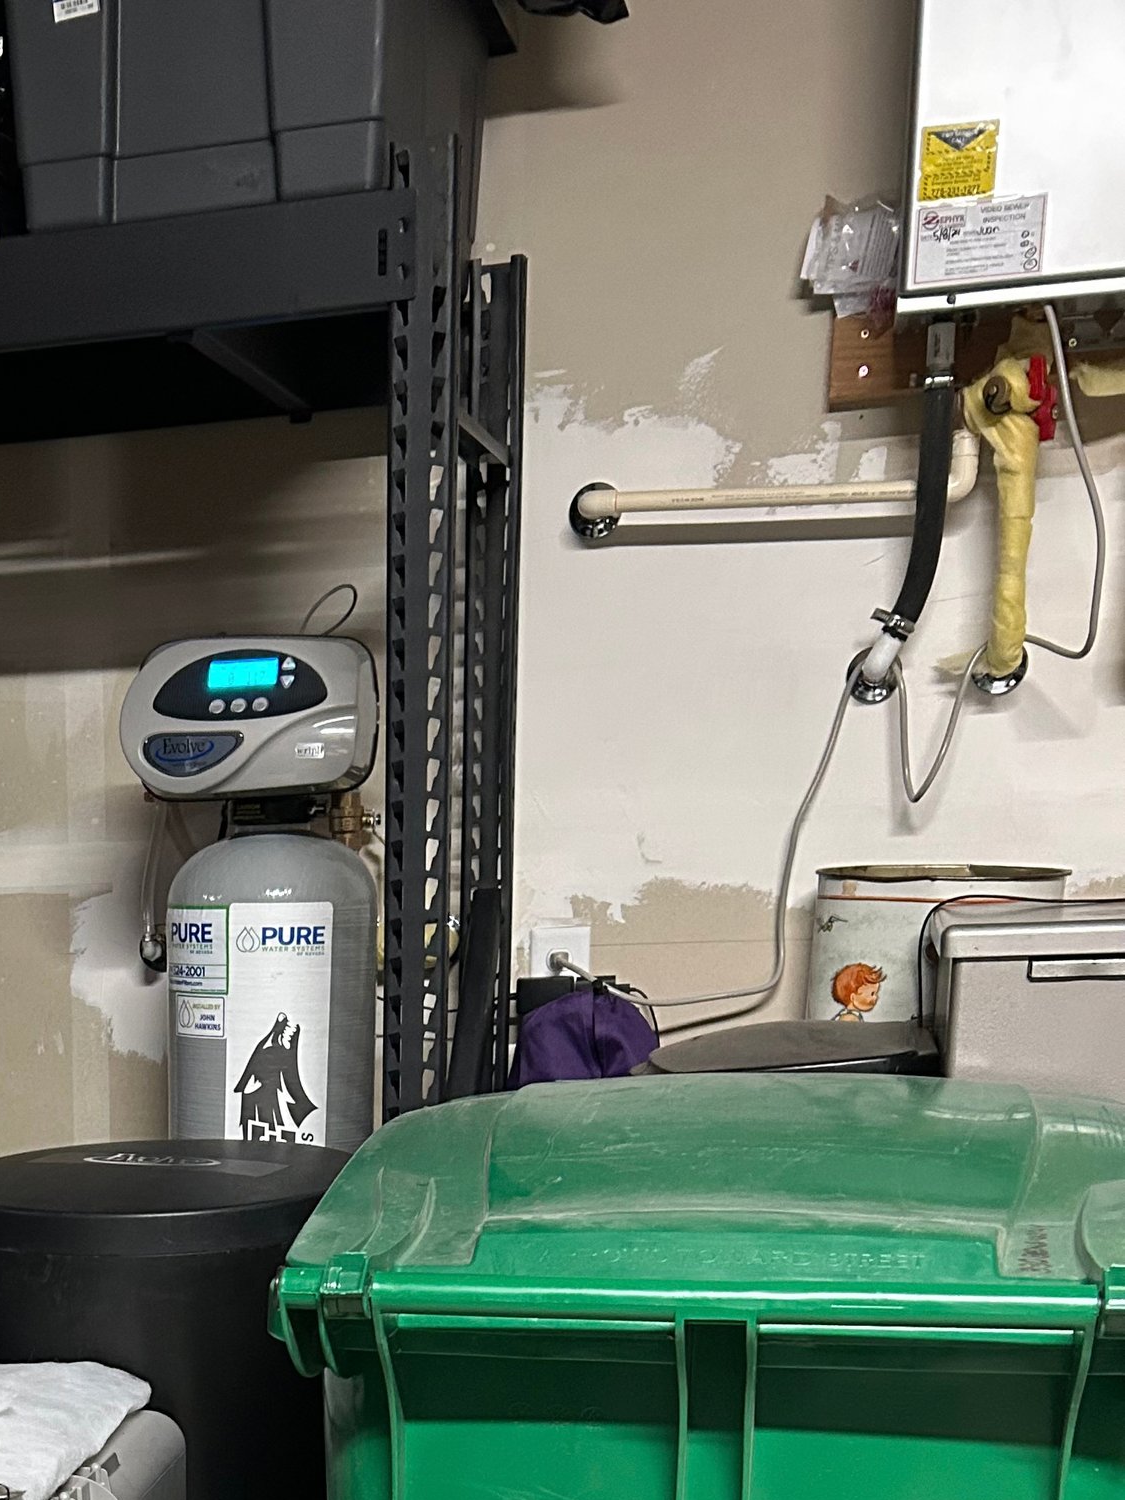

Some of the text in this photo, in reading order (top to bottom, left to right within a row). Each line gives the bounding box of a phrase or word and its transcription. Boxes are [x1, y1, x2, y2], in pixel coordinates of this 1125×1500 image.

[980, 205, 1003, 213] VIDEO
[982, 213, 1026, 224] INSPECTION
[162, 737, 206, 755] Evolve
[171, 922, 213, 943] PURE
[261, 925, 326, 946] PURE
[291, 945, 325, 953] SYSTEMS
[199, 1014, 216, 1022] JOHN
